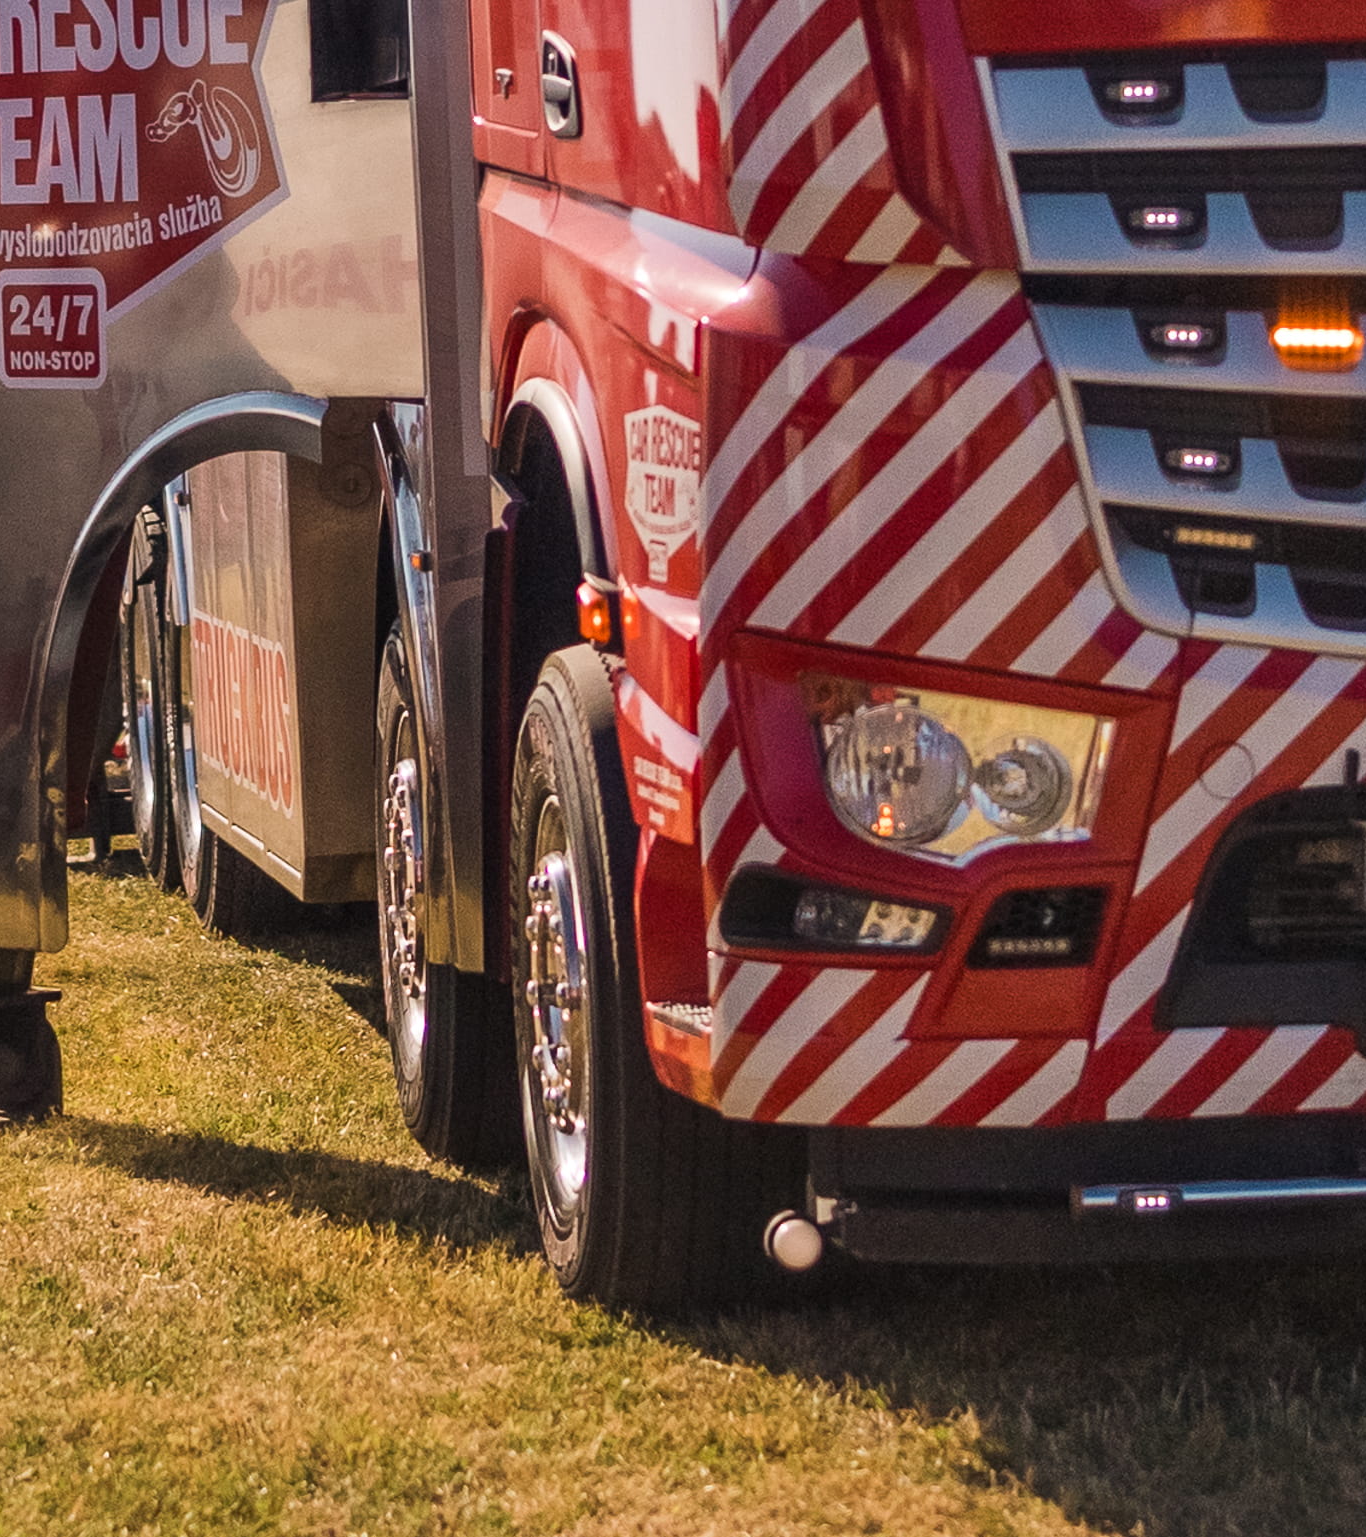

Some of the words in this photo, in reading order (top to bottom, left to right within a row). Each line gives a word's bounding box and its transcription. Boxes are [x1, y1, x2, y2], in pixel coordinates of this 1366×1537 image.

[161, 195, 222, 241] služba
[9, 295, 94, 341] 24/7
[10, 350, 95, 371] NON-STOP
[630, 418, 648, 462] CAR
[652, 416, 701, 471] RESCUE
[644, 474, 676, 517] TEAM
